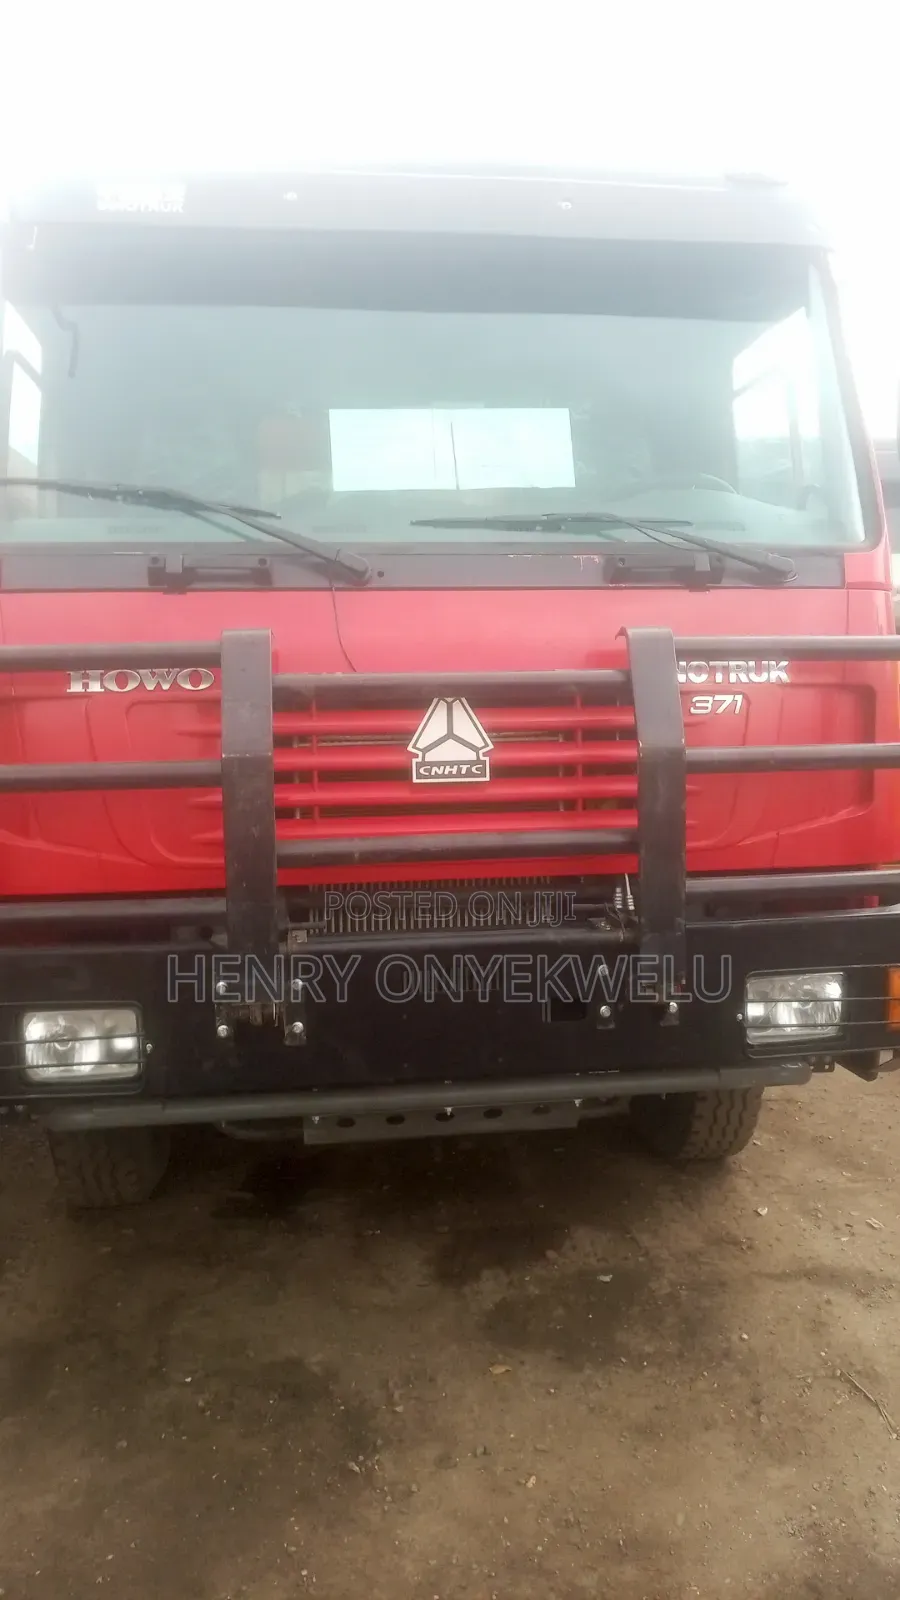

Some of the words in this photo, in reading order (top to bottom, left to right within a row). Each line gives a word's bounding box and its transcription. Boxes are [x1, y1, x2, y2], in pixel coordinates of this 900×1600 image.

[66, 667, 215, 692] HOWO
[690, 694, 743, 714] 371
[419, 764, 483, 776] CNHTC
